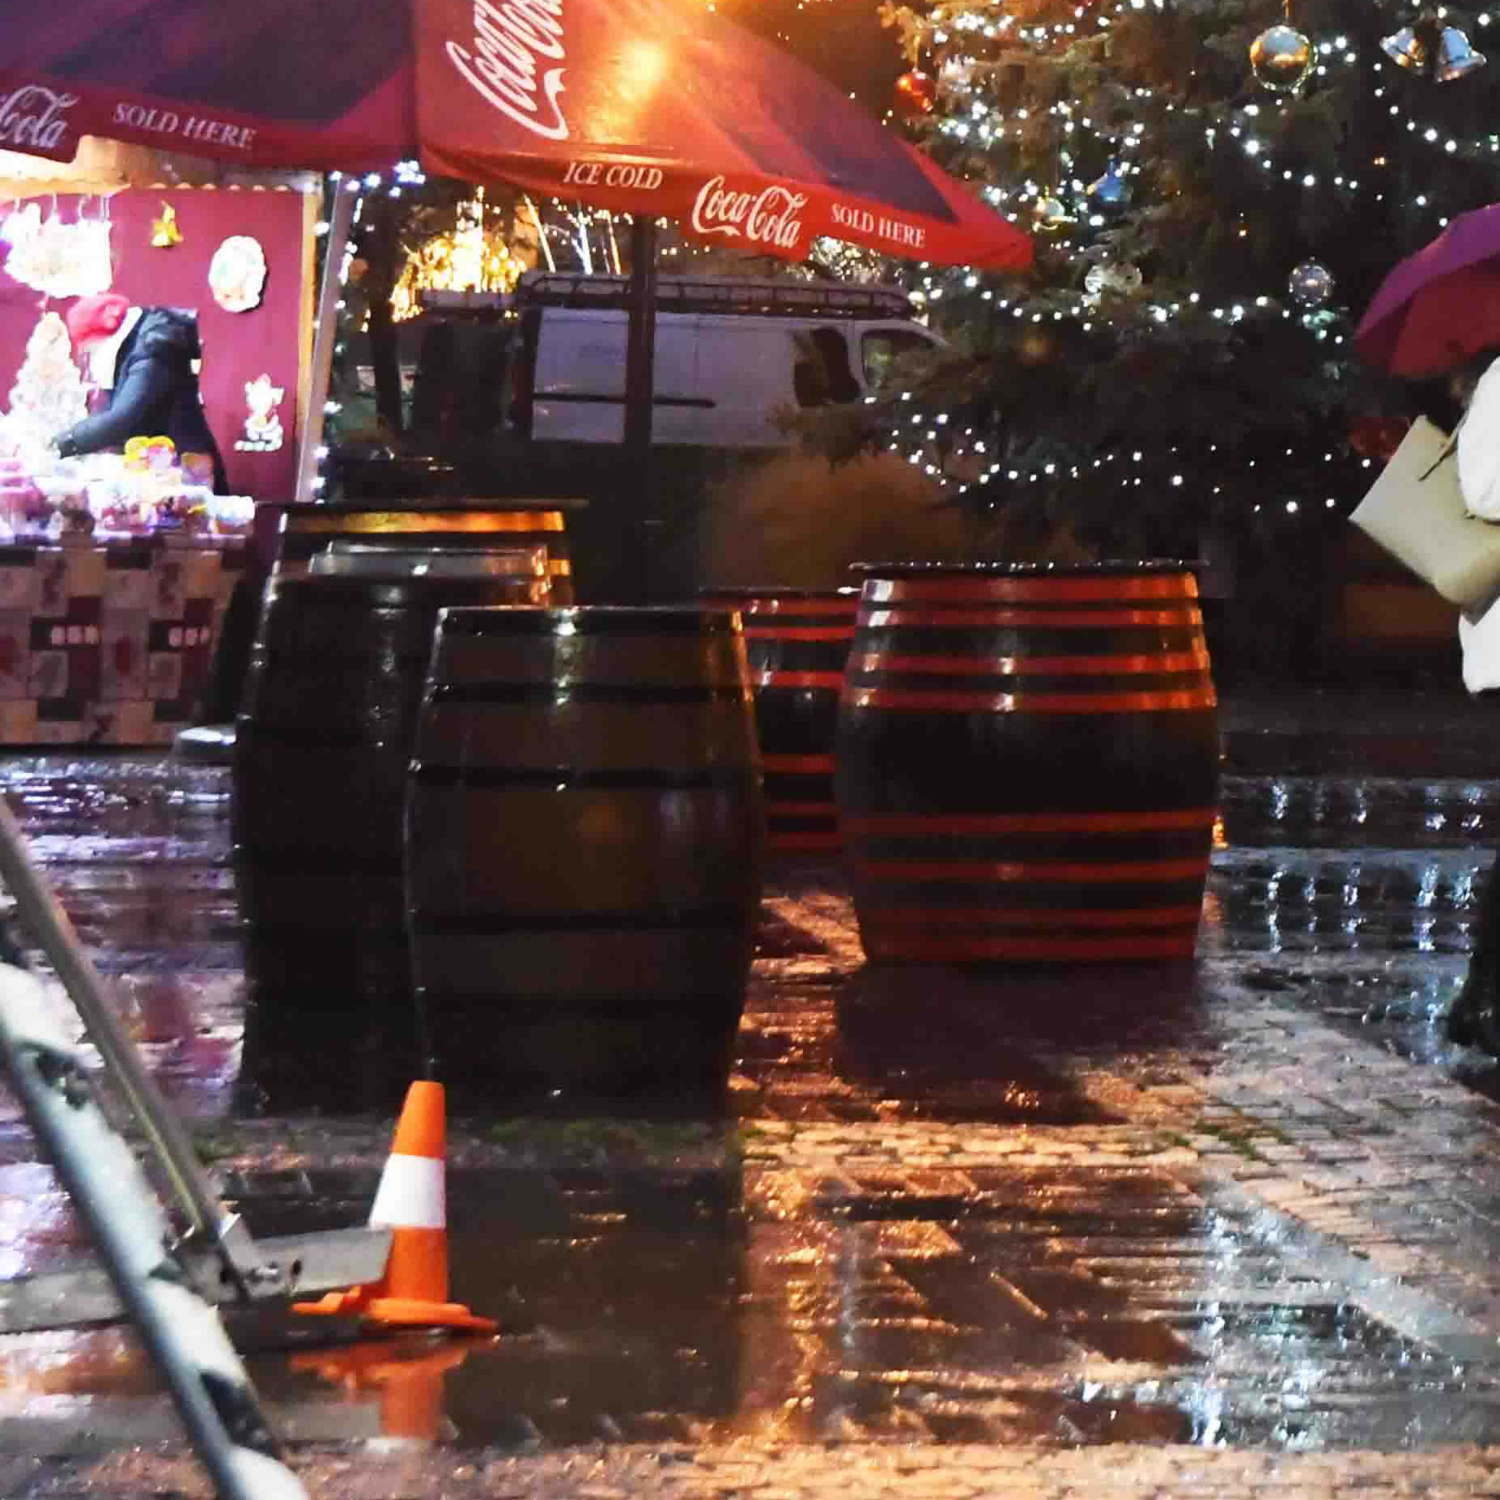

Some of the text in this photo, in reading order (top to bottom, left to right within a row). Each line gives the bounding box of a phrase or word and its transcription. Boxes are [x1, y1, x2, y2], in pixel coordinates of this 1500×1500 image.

[113, 102, 258, 149] SOLD HERE
[562, 161, 664, 190] ICE COLD
[691, 175, 808, 249] Coca-Cola
[830, 202, 926, 249] SOLD HERE
